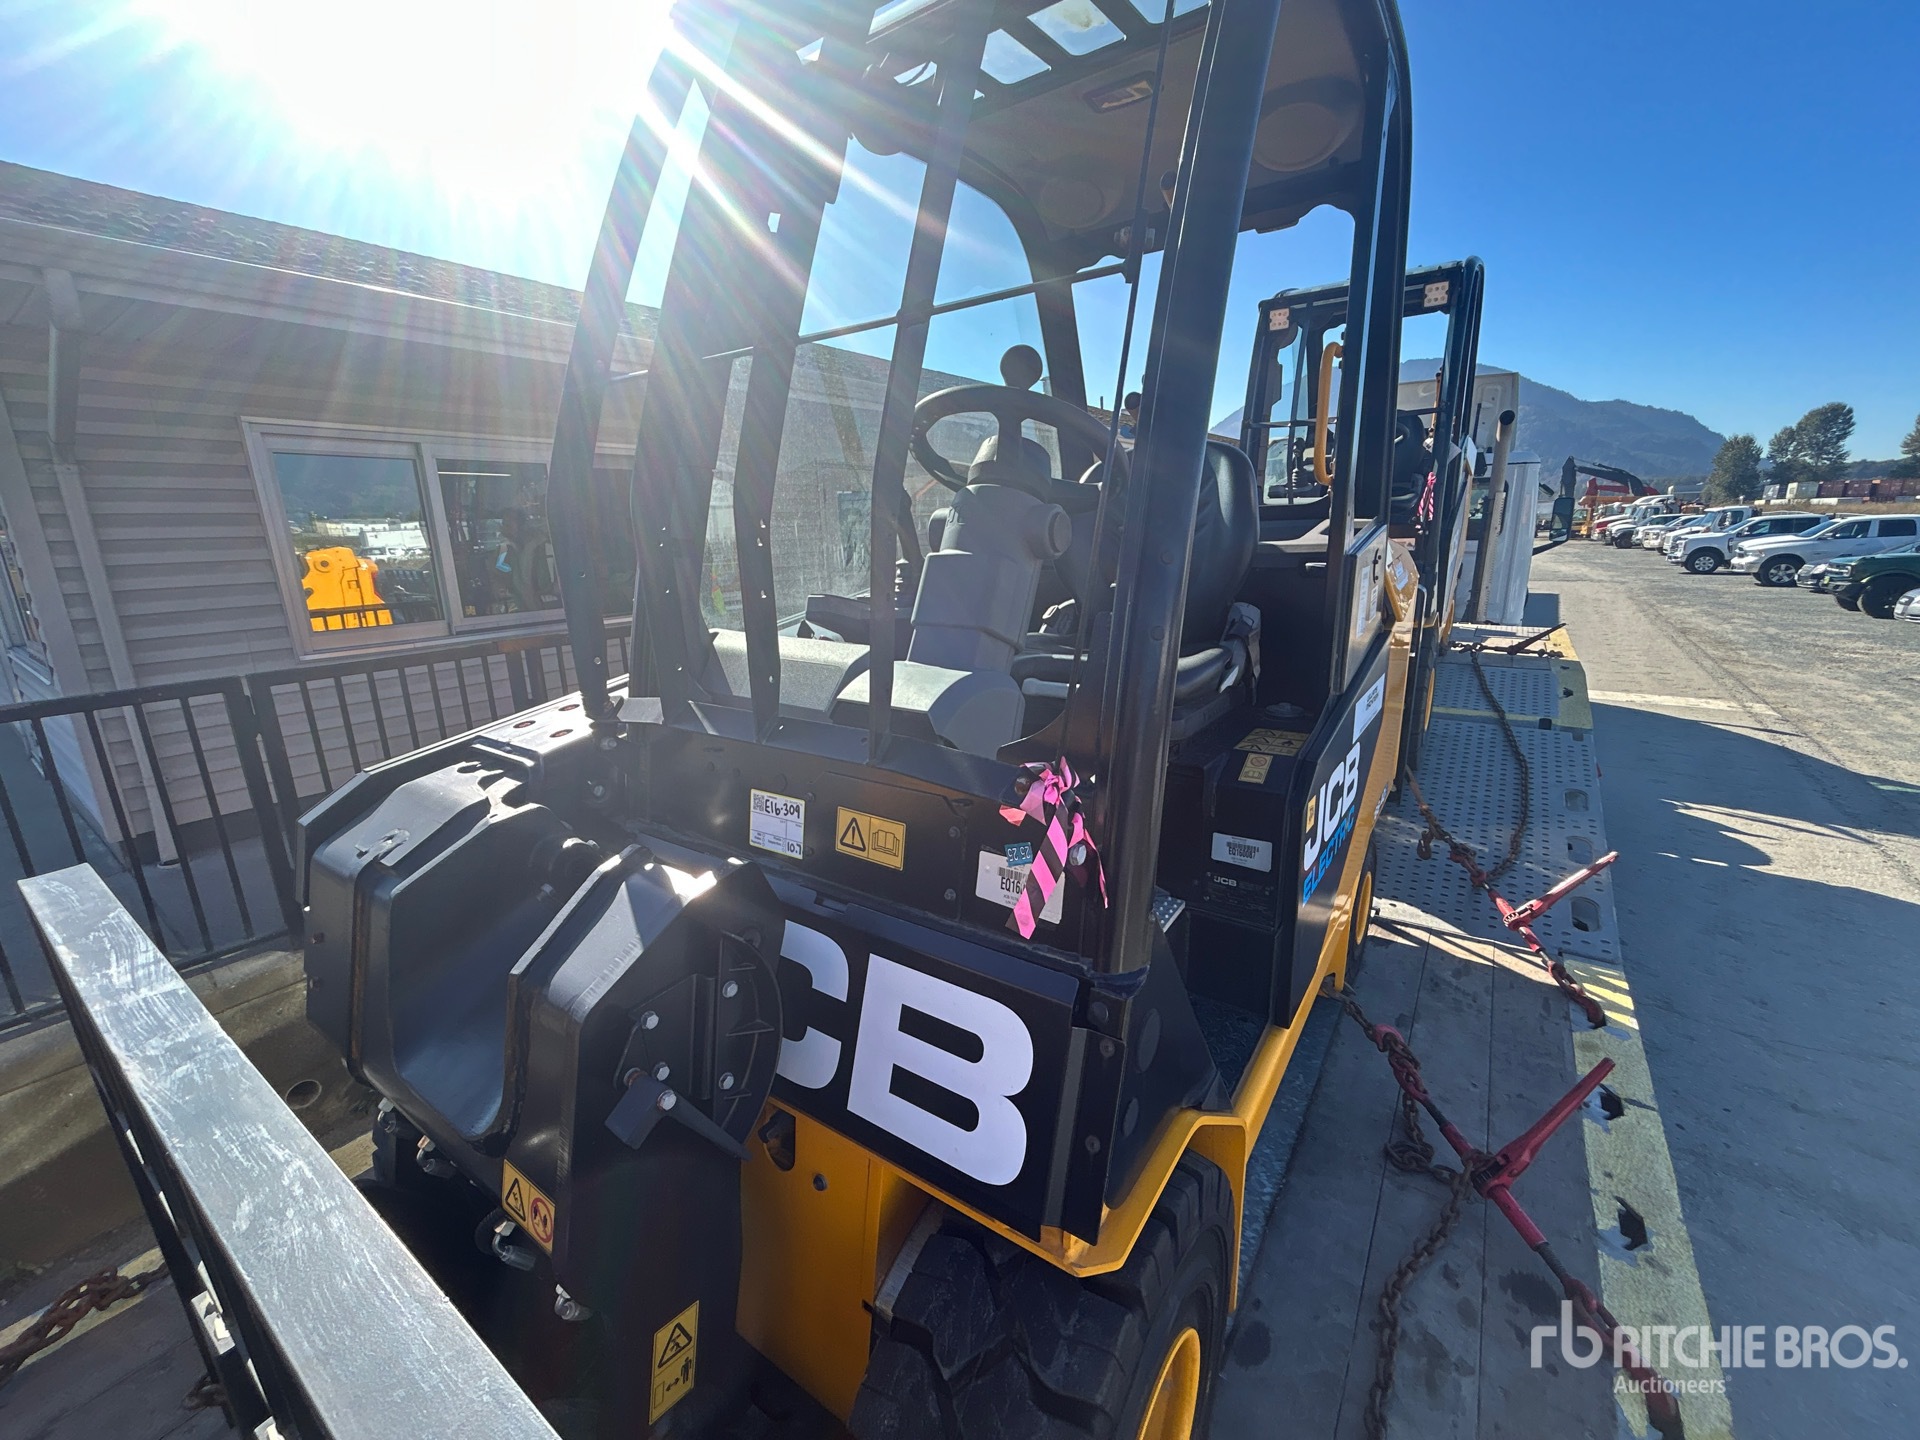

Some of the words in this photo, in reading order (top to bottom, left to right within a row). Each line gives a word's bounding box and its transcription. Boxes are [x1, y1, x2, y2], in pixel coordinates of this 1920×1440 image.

[1304, 742, 1361, 871] JCB
[1213, 875, 1238, 887] JCB
[775, 918, 1035, 1187] CB
